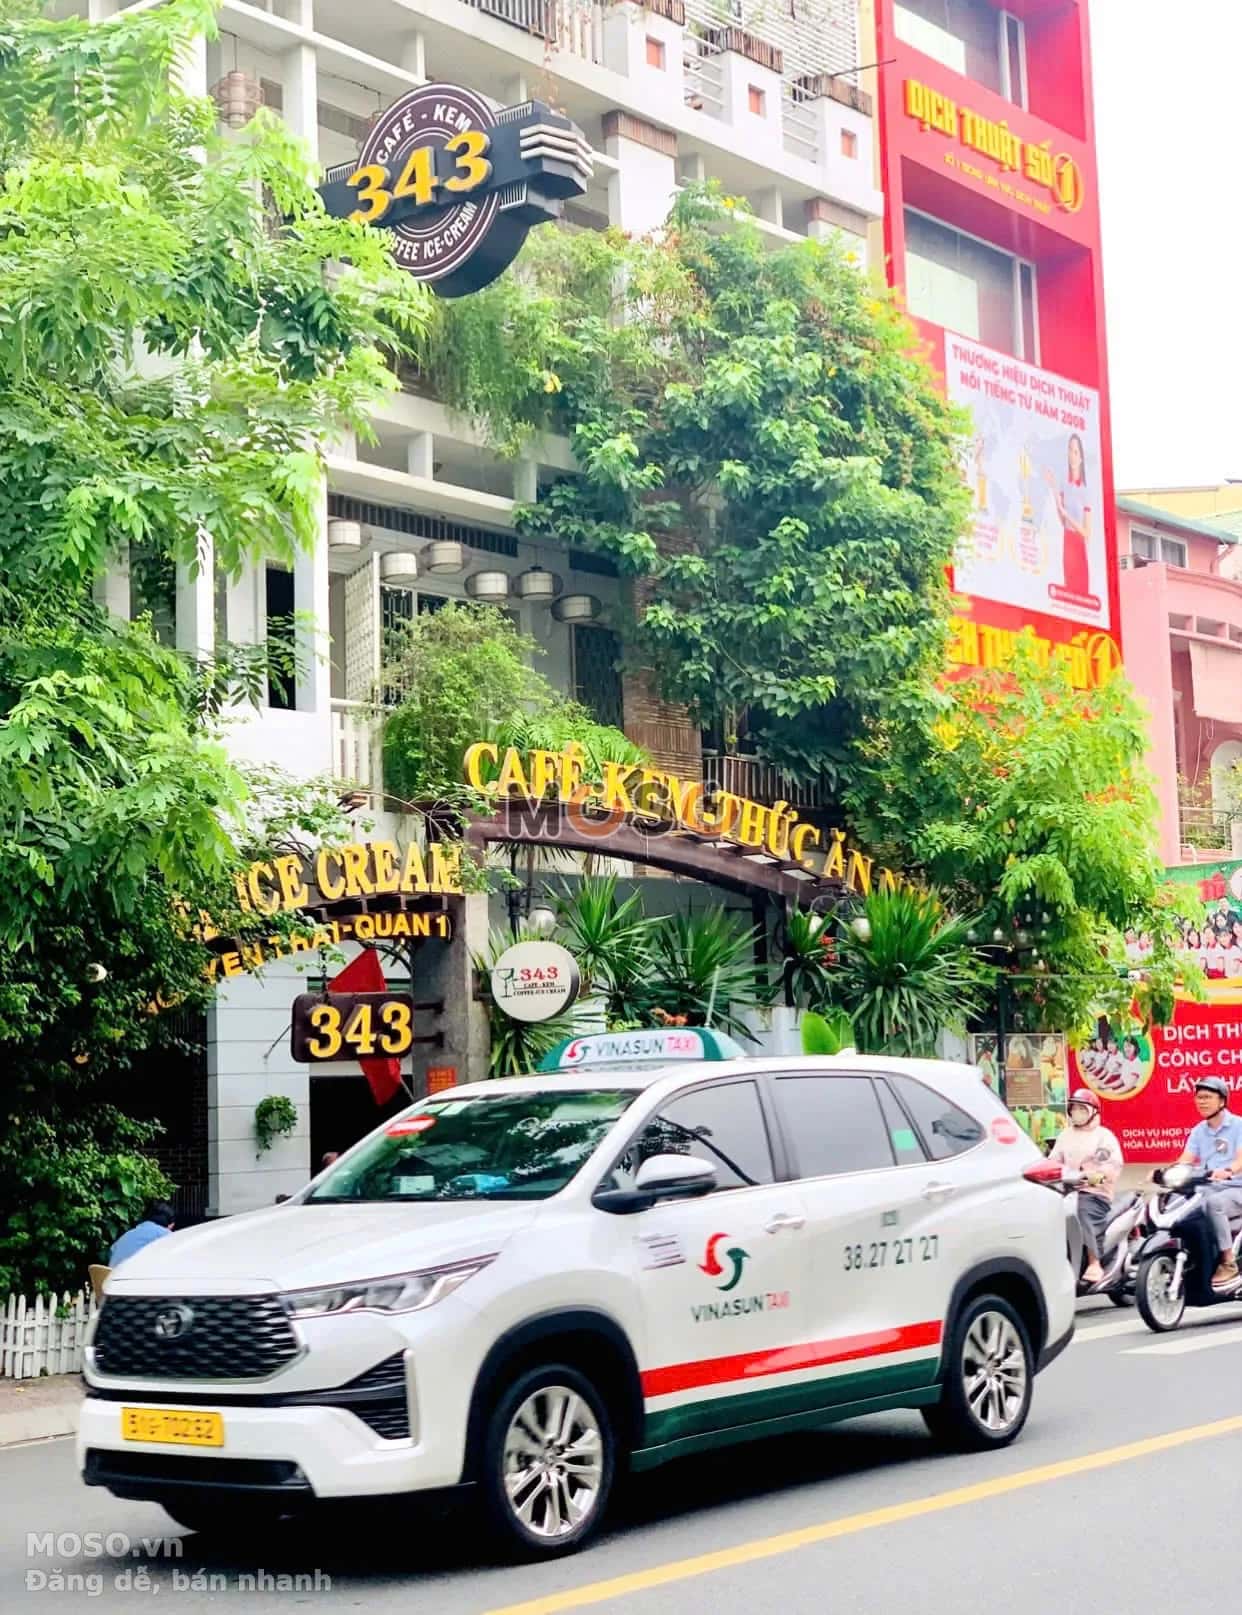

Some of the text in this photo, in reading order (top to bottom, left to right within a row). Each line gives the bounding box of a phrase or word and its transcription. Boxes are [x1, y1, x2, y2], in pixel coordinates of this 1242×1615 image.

[375, 110, 415, 165] CAFÉ
[433, 103, 473, 134] KEM
[904, 80, 958, 138] DỊCH
[958, 107, 1021, 173] THUẬT
[346, 130, 490, 224] 343
[234, 840, 464, 915] ICE CREAM
[520, 966, 558, 981] 343
[307, 1001, 412, 1058] 343
[1163, 1024, 1209, 1045] DỊCH
[593, 1039, 664, 1058] VINASUN
[1158, 1048, 1213, 1068] CÔNG
[843, 1234, 938, 1271] 38.27 27 27
[690, 1295, 763, 1323] VINASUN
